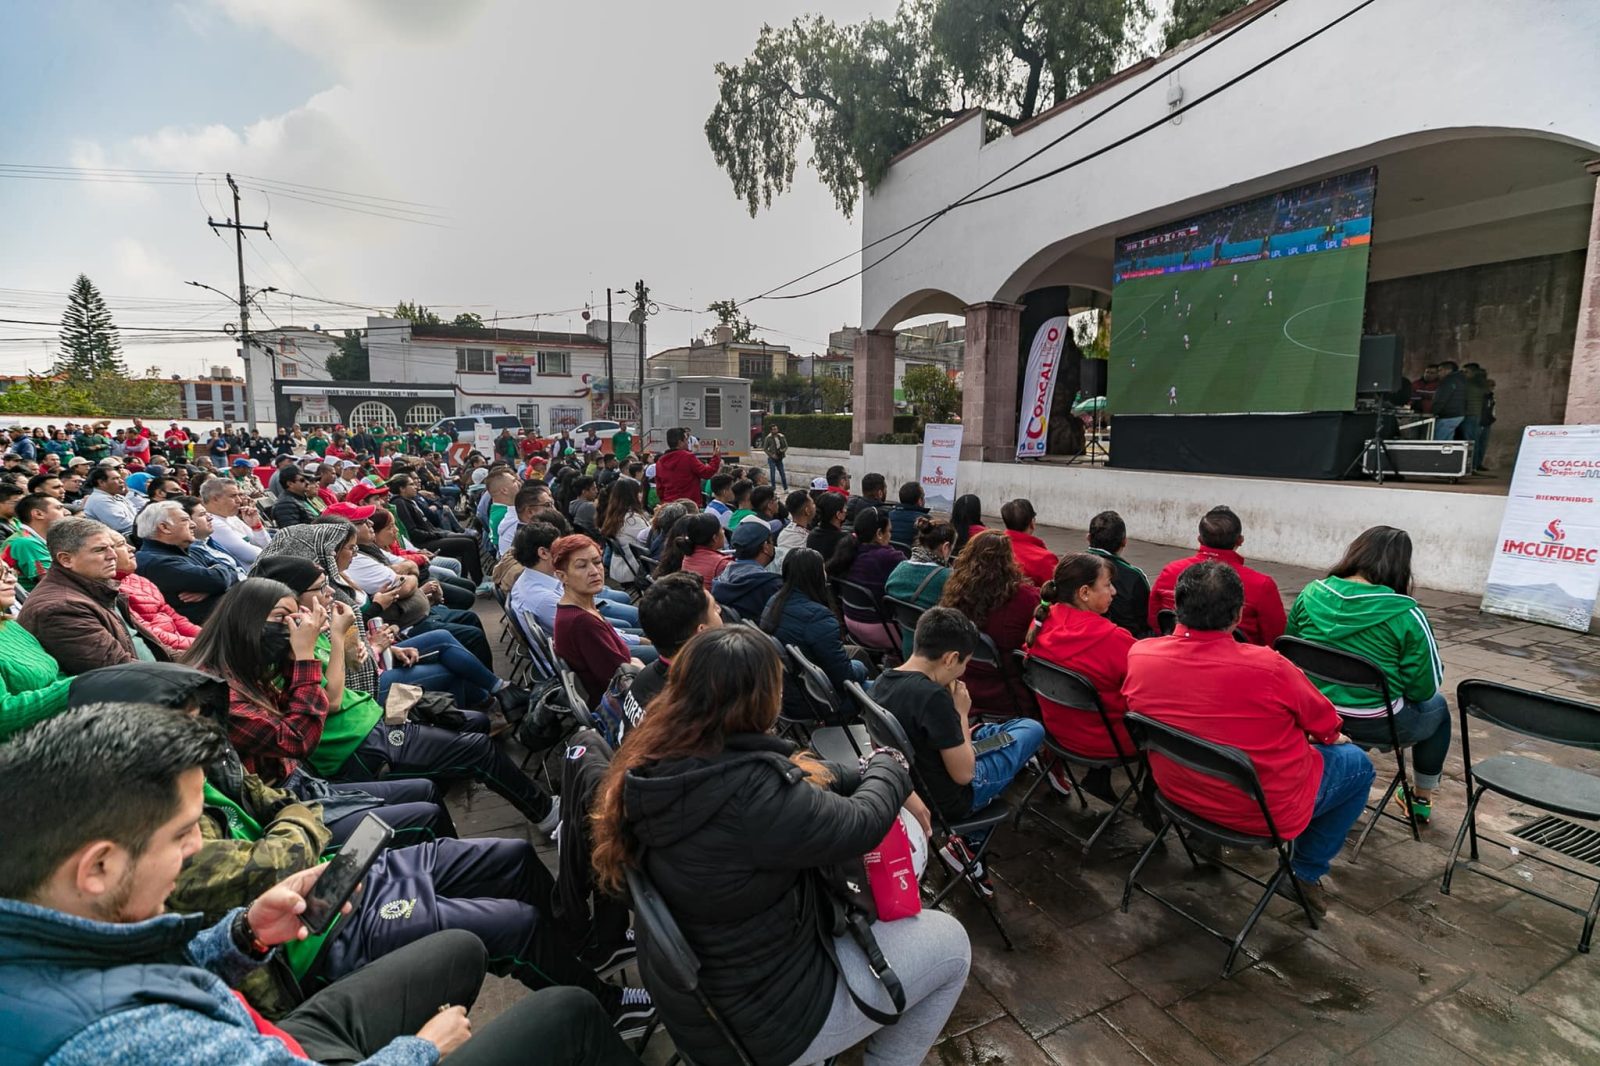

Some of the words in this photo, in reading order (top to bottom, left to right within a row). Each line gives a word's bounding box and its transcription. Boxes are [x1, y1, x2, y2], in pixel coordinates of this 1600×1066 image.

[1271, 249, 1282, 258] UPL
[1287, 246, 1299, 256] UPL
[1305, 243, 1318, 253] UPL
[1535, 494, 1594, 503] BIENVENIDOS
[1503, 540, 1598, 563] IMCUFIDEC
